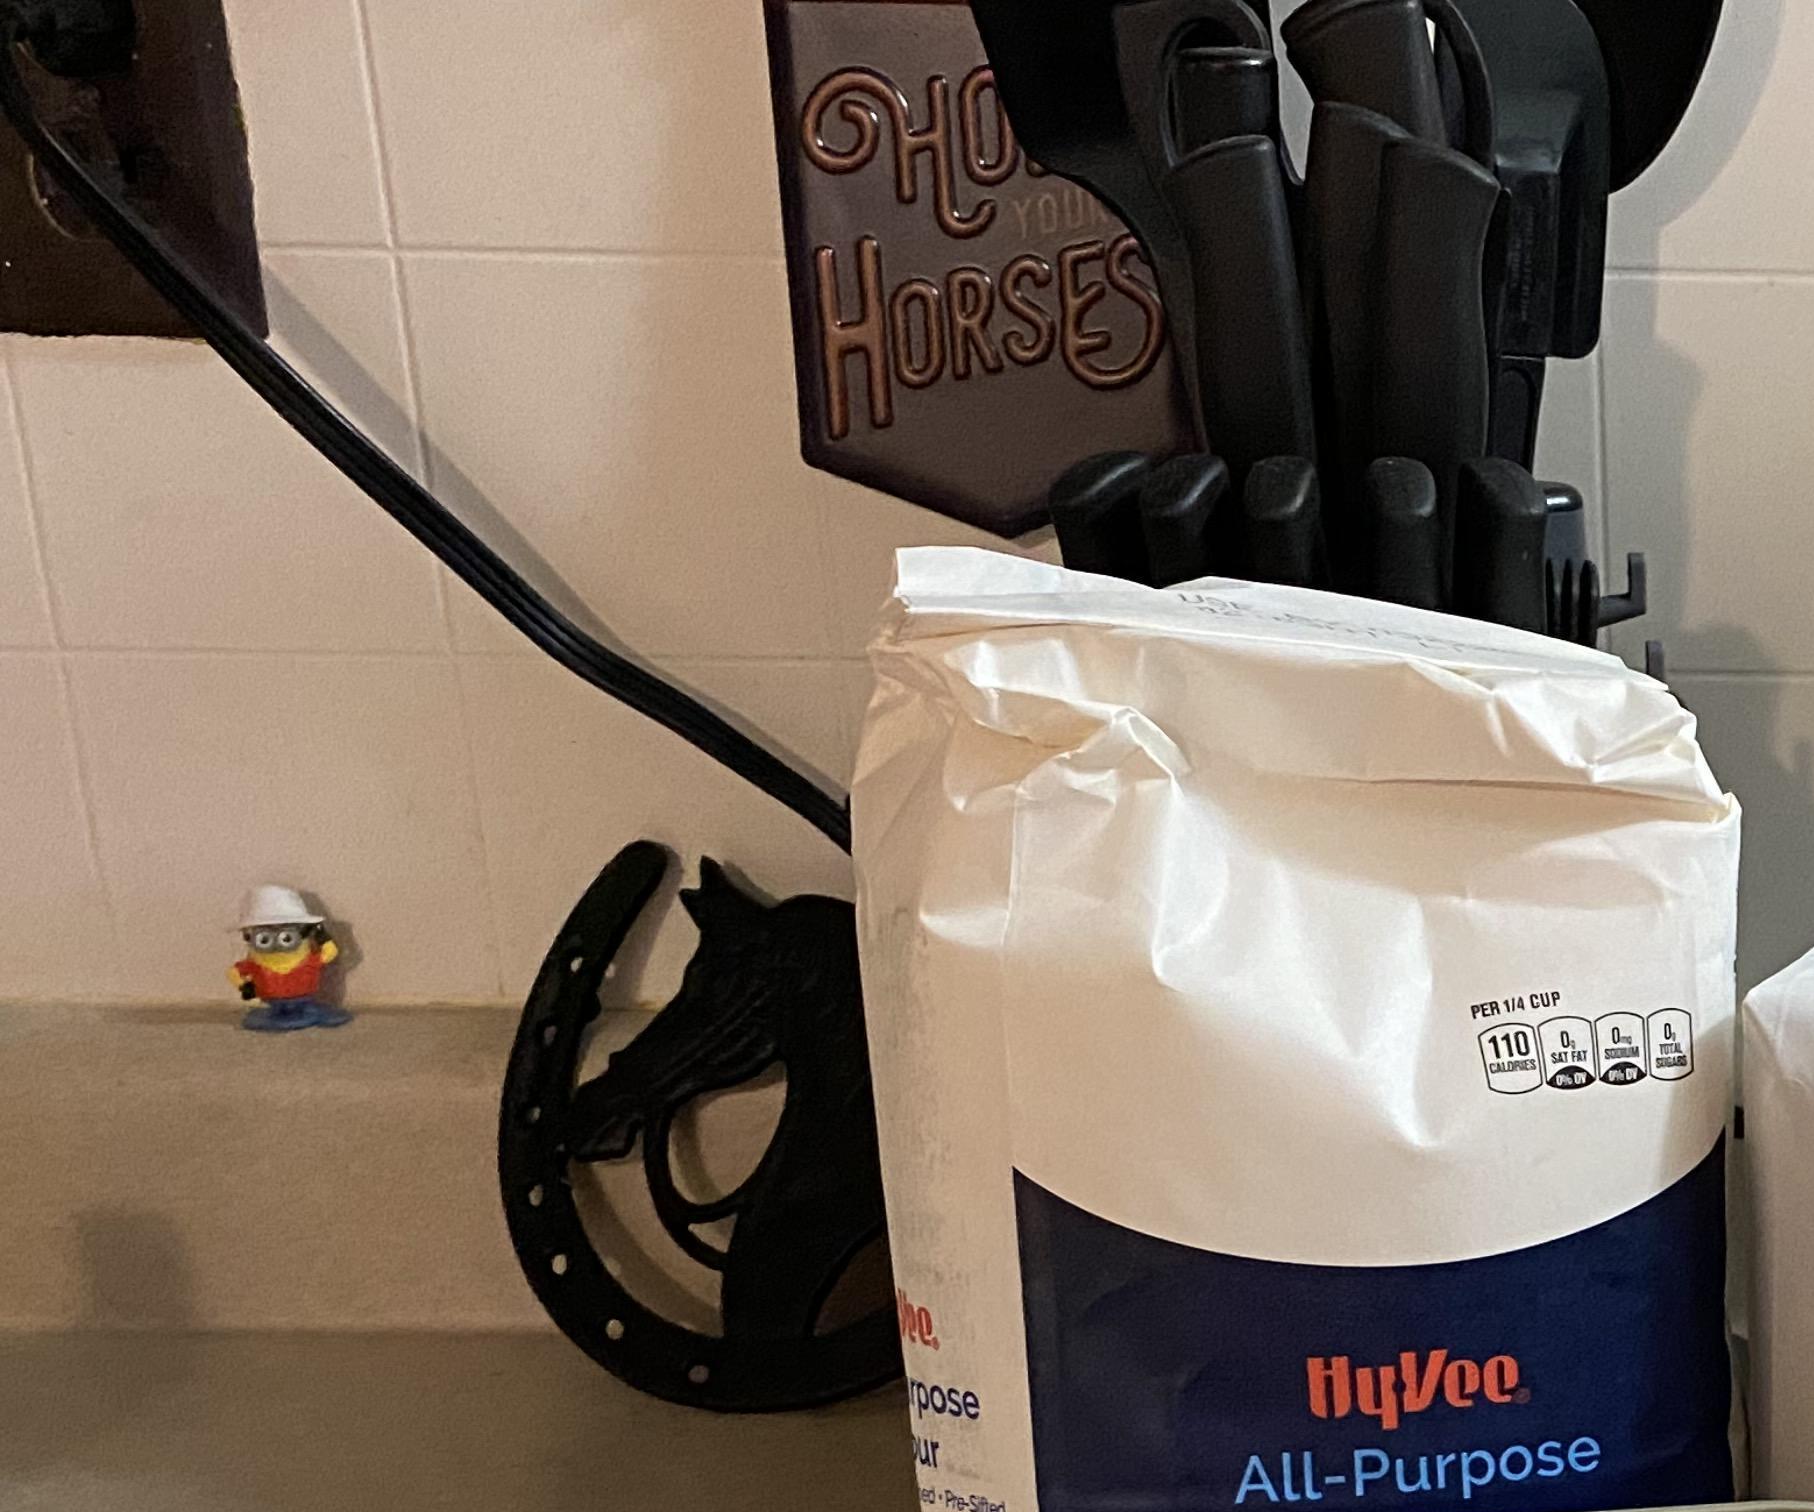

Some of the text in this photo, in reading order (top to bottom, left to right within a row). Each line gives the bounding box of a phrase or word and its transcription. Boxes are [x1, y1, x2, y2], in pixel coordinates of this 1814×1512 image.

[802, 64, 1018, 238] HO
[815, 234, 1165, 440] HORSES
[1470, 991, 1561, 1019] PER 1/4 CUP
[1487, 1030, 1531, 1060] 110
[1550, 1049, 1588, 1064] SAT FAT
[1659, 1042, 1683, 1056] TOTAL
[1489, 1058, 1538, 1074] CALORIES
[1306, 1349, 1520, 1431] HyVee
[1234, 1436, 1601, 1505] All-Purpose
